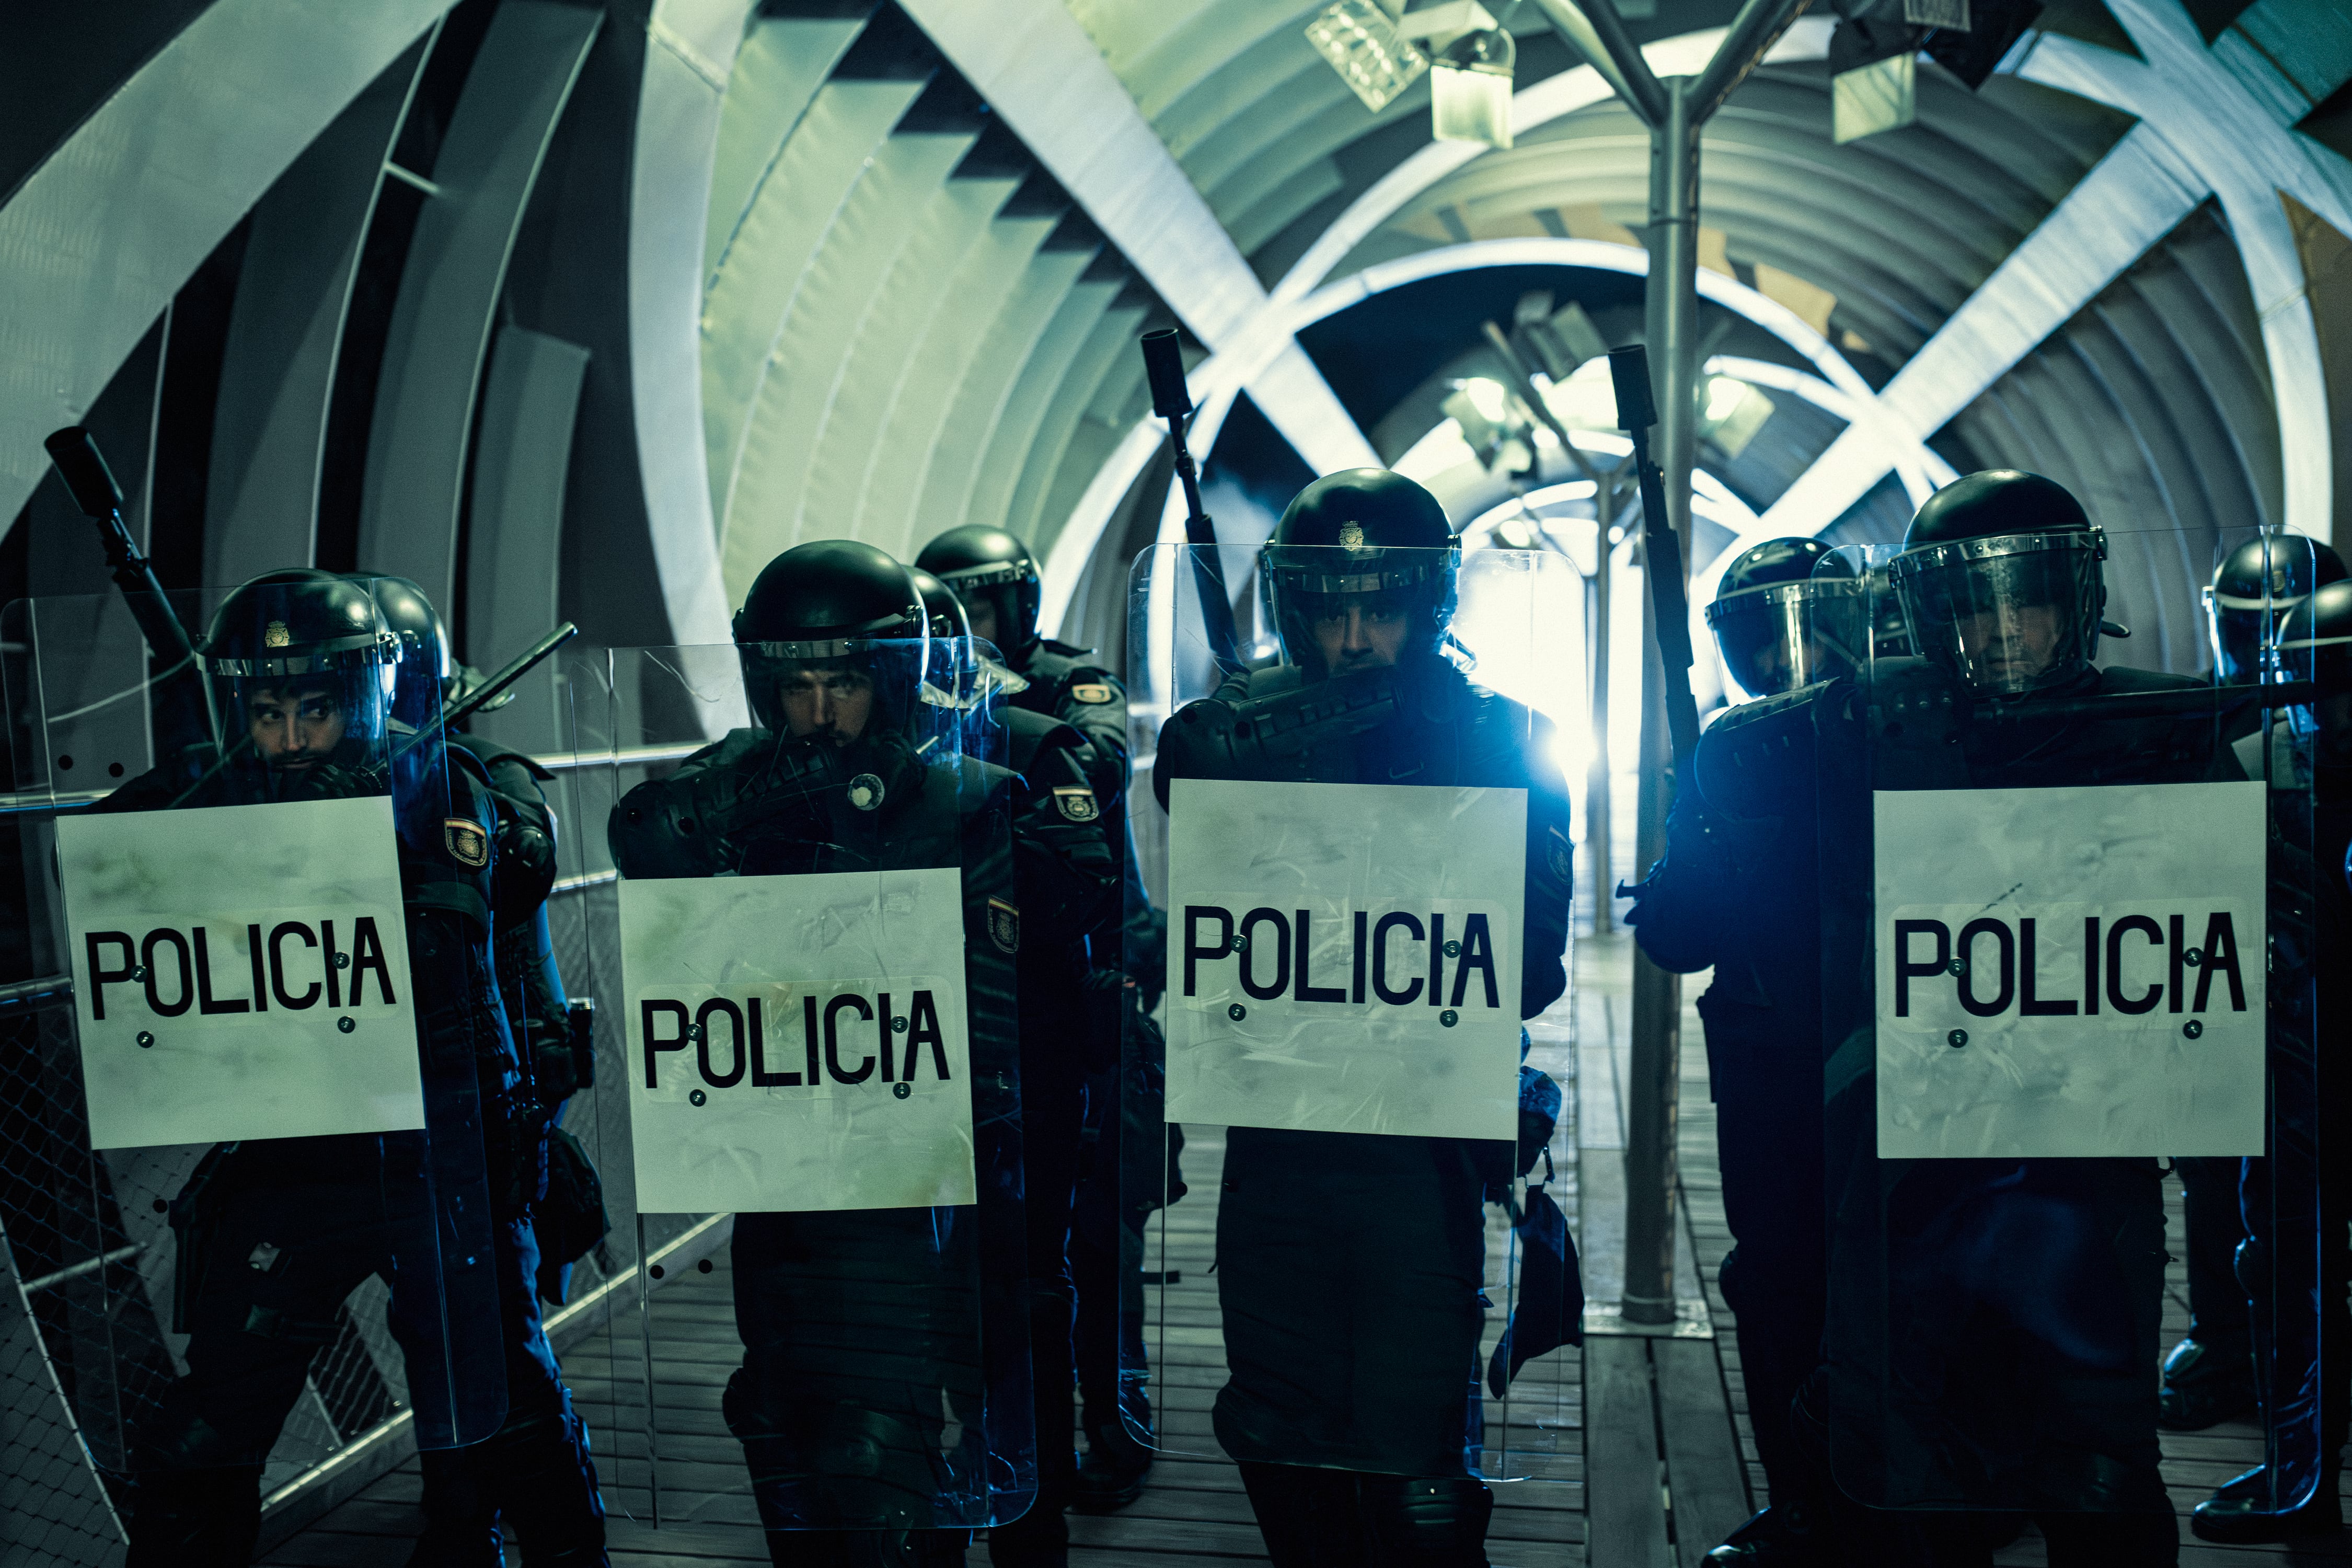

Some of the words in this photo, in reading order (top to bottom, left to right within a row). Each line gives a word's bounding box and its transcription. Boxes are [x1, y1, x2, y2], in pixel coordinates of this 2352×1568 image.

[85, 916, 396, 1020] POLICIA
[1183, 905, 1500, 1008] POLICIA
[1895, 912, 2247, 1017] POLICIA
[641, 990, 951, 1089] POLICIA
